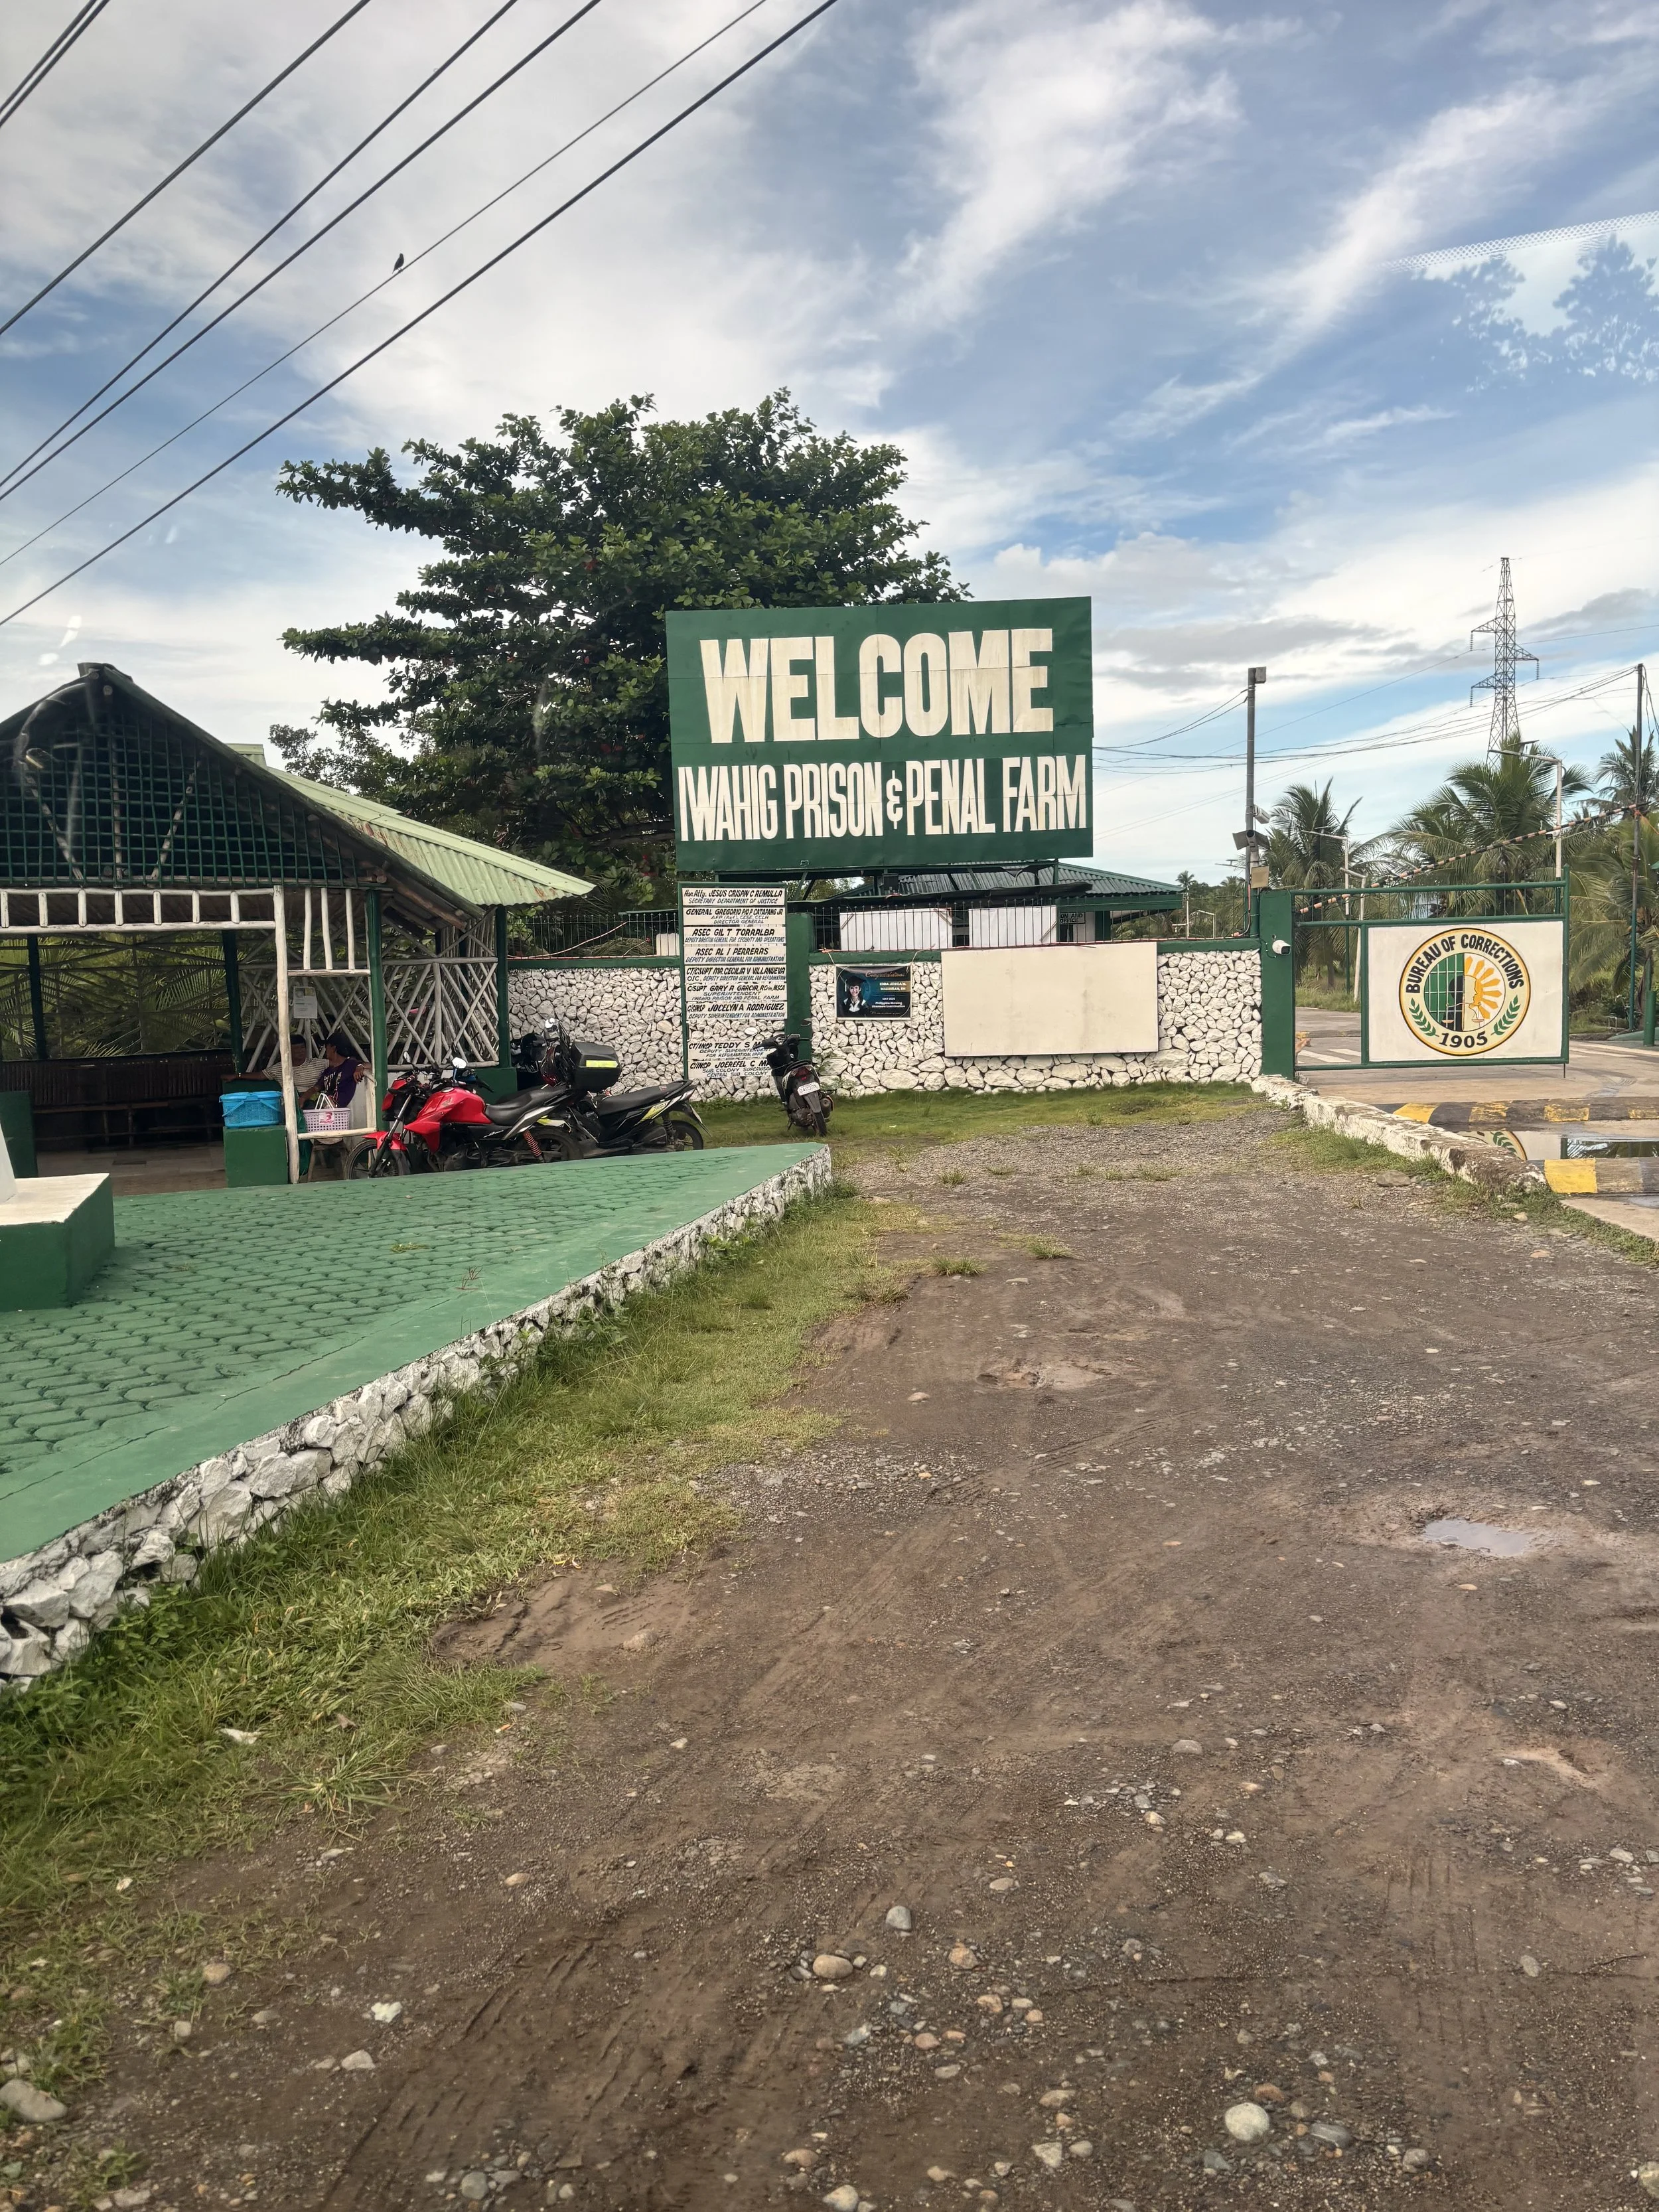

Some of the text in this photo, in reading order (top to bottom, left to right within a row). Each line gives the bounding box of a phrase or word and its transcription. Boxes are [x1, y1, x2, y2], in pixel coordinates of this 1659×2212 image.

[699, 628, 1054, 744] WELCOME
[678, 755, 1086, 842] IWAHIG PRISON & PENAL FARM
[755, 889, 783, 898] REMULLA
[1406, 934, 1525, 994] BUREAU OF CORRECTIONS
[1439, 1031, 1488, 1049] 1905
